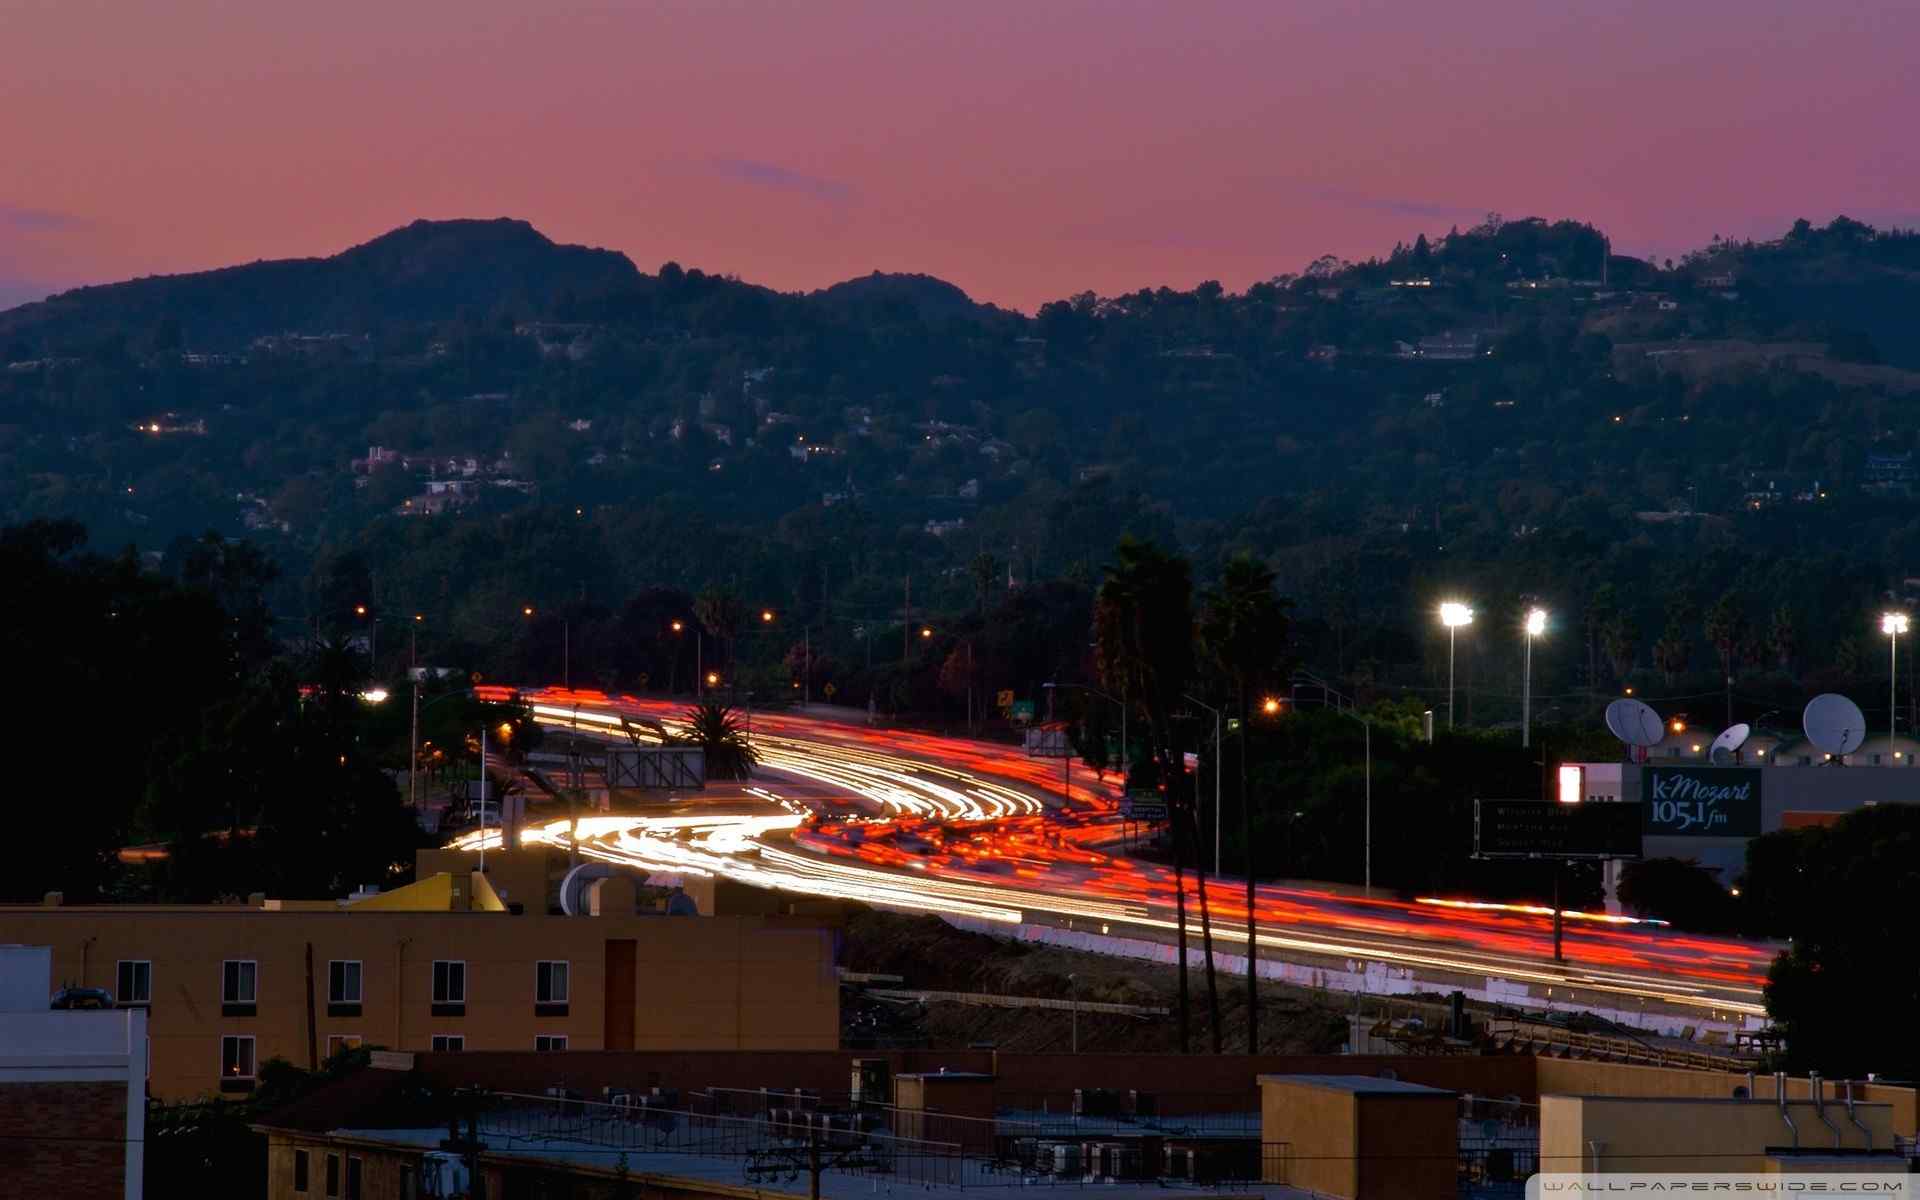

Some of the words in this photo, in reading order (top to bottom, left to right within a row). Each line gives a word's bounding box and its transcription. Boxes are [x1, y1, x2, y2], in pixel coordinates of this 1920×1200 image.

[1652, 773, 1751, 806] k-Mozart
[1652, 800, 1704, 830] 105.1
[1703, 809, 1728, 830] fm
